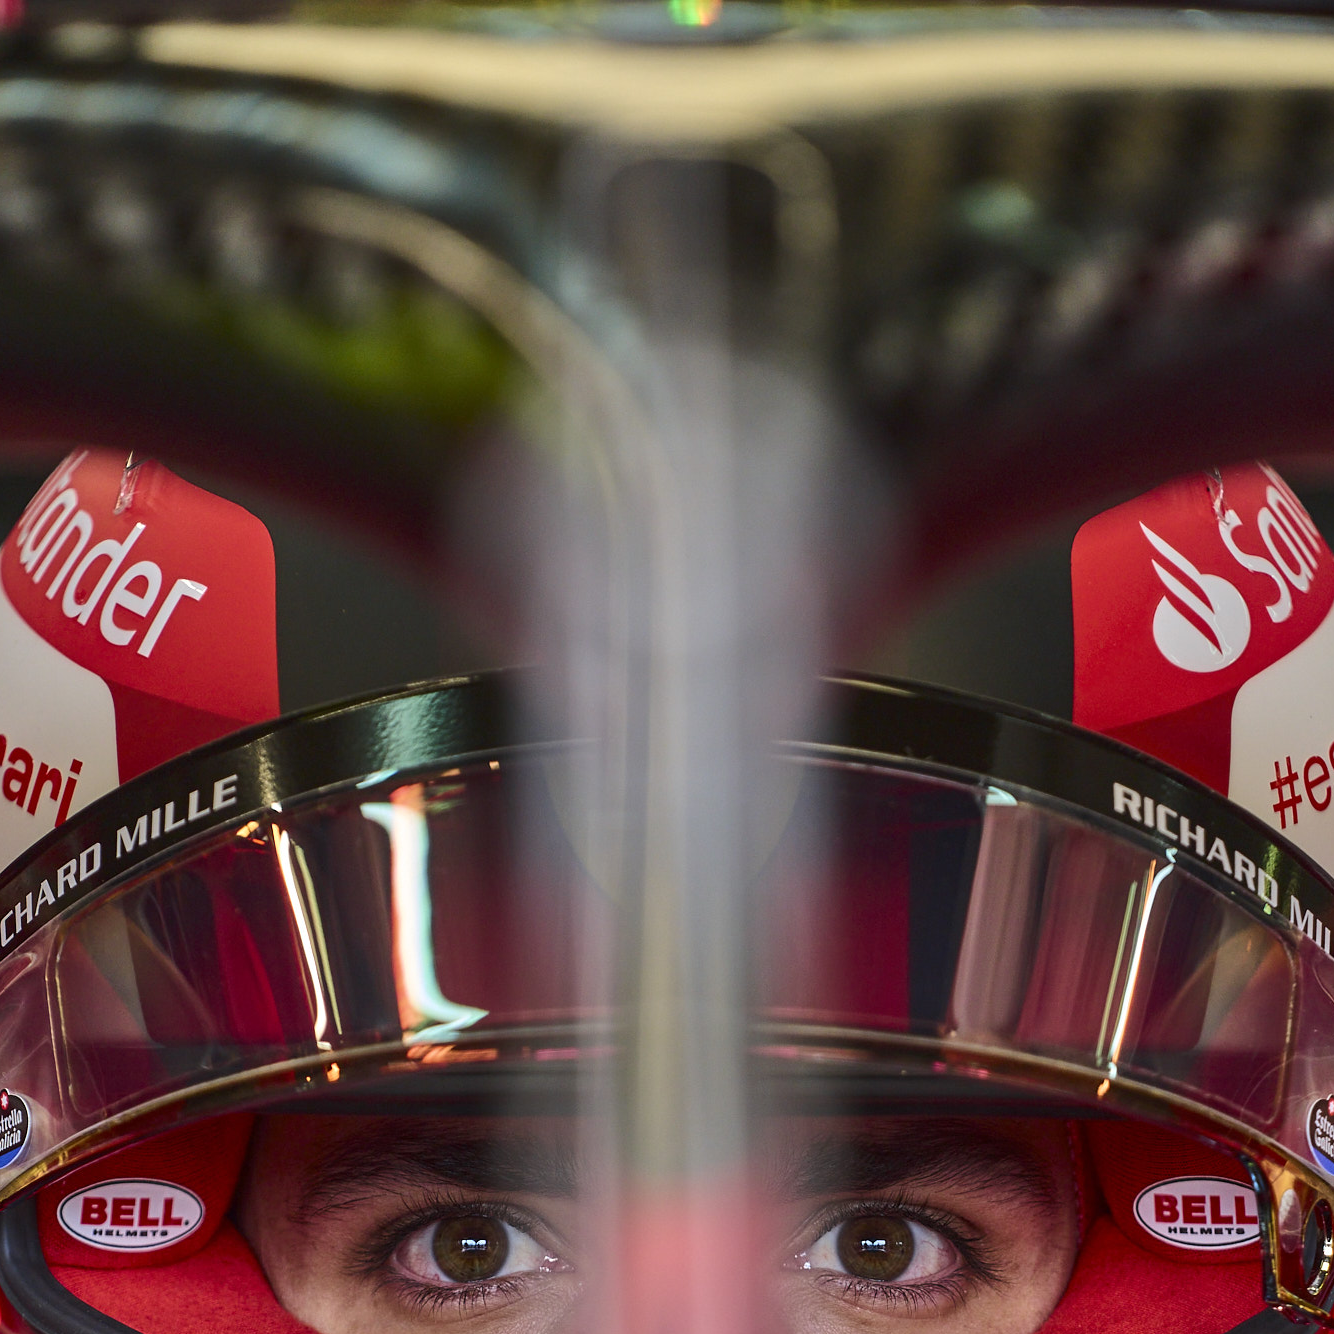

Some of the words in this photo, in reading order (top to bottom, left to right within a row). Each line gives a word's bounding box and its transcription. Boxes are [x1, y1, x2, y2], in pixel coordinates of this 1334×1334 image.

[116, 774, 238, 858] MILLE
[1113, 782, 1279, 907] RICHARD
[80, 1196, 184, 1227] BELL
[1154, 1194, 1258, 1225] BELL
[92, 1229, 169, 1237] HELMETS
[1168, 1226, 1245, 1235] HELMETS
